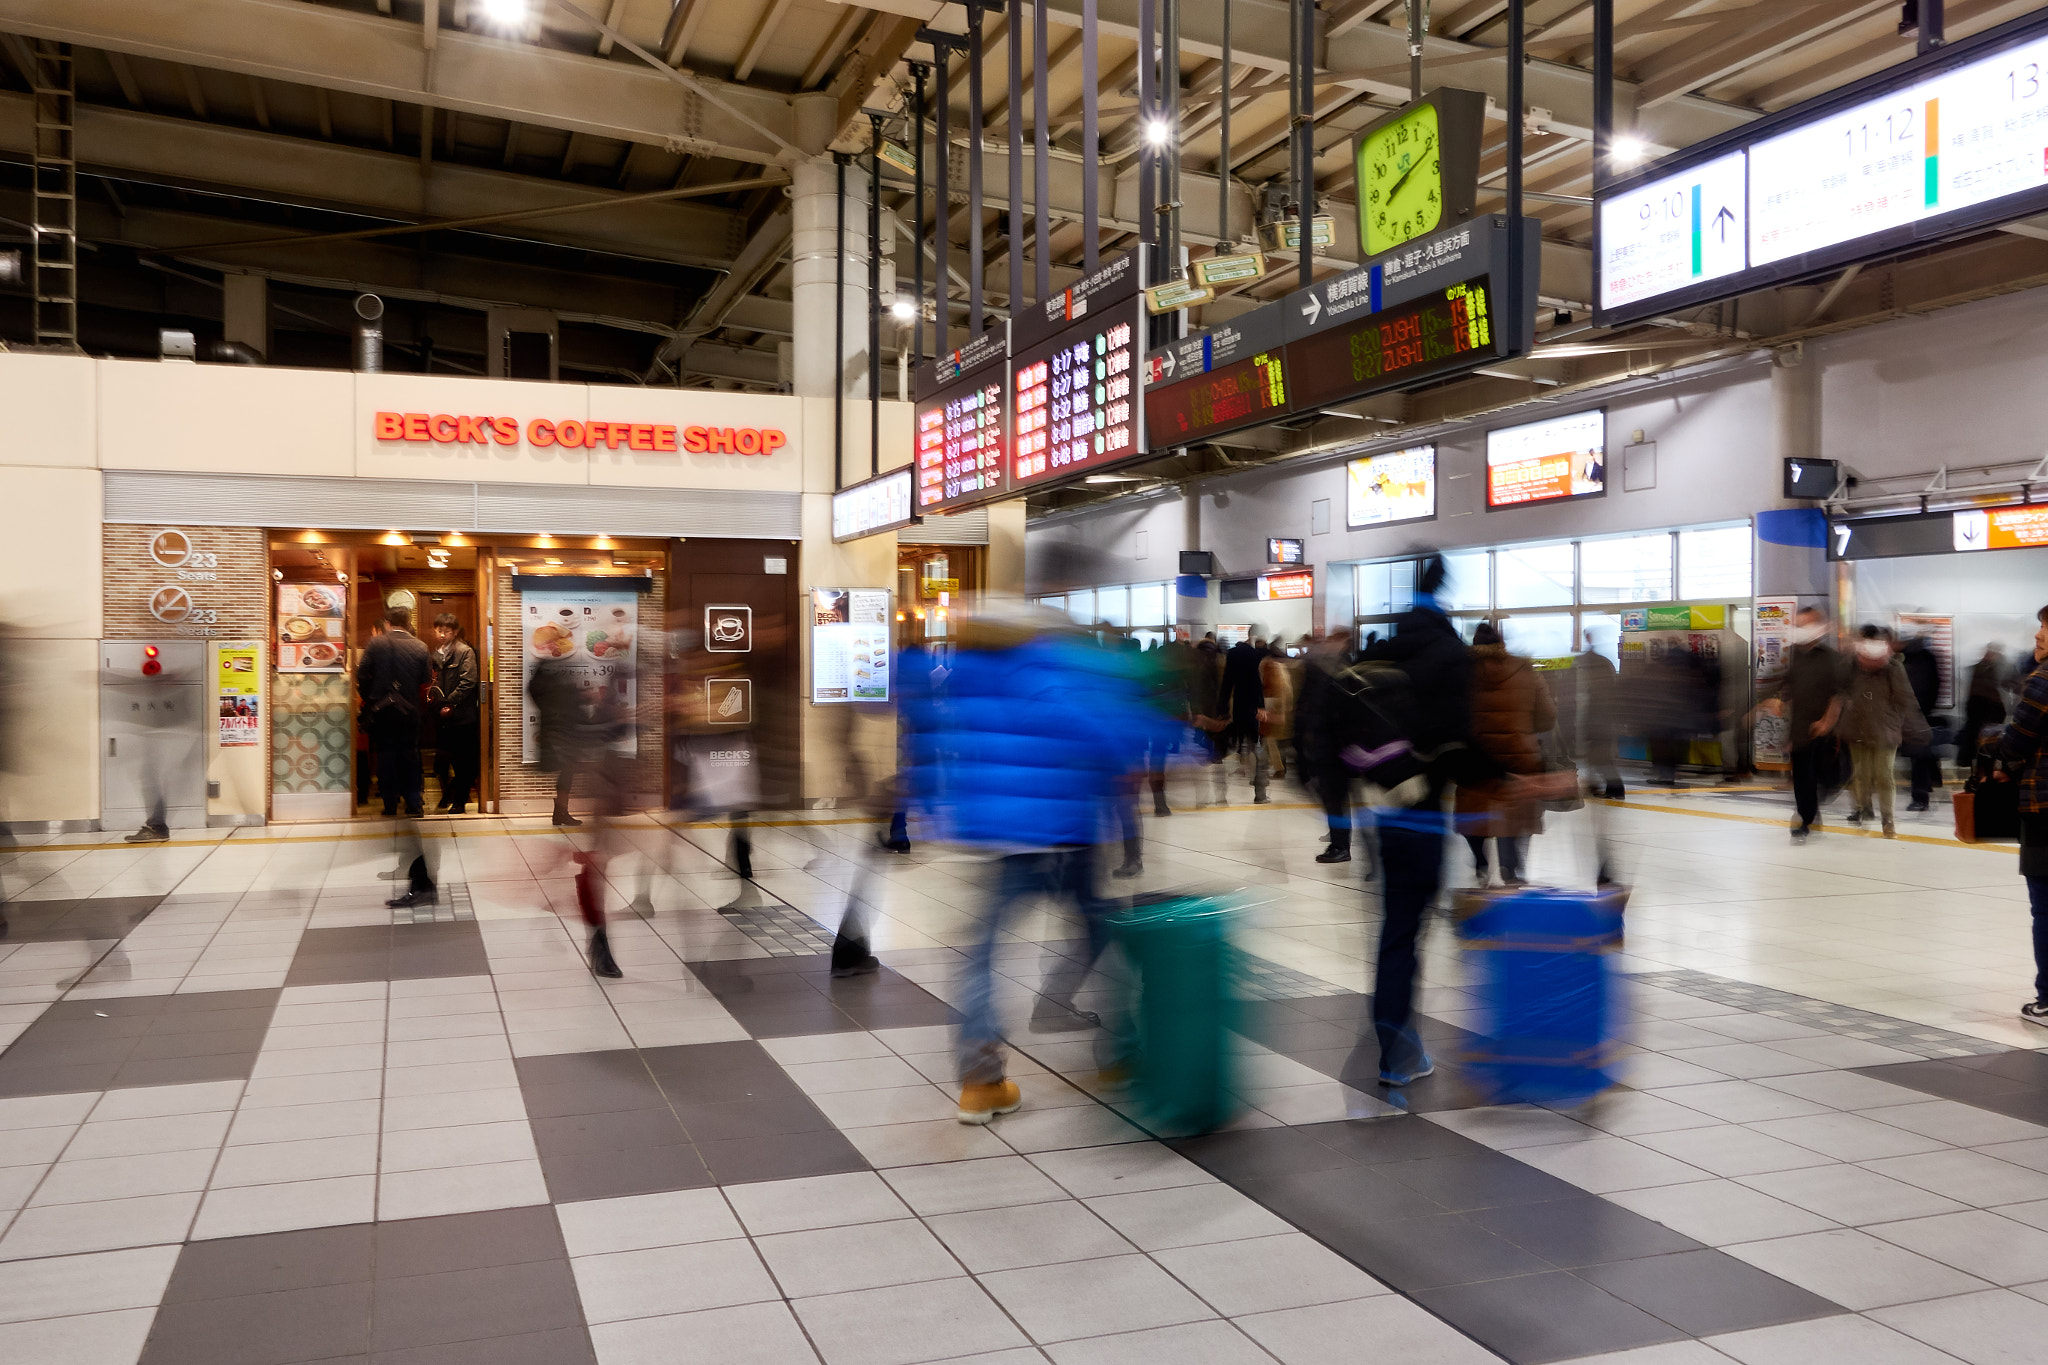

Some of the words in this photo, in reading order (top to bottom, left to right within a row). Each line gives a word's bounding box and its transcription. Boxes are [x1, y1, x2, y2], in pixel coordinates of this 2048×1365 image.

[1417, 264, 1432, 275] Zushi
[1327, 272, 1369, 303] 横須賀線
[1446, 283, 1467, 300] のりば
[1326, 298, 1355, 317] Yokosuka
[1355, 294, 1369, 307] Line
[1381, 313, 1421, 346] ZUSHI
[1052, 349, 1072, 375] 8:17
[1383, 341, 1424, 372] ZUSHI
[1052, 373, 1072, 398] 8:27
[1052, 398, 1071, 421] 8:32
[375, 411, 520, 446] BECK'S
[526, 418, 678, 453] COFFEE
[683, 425, 787, 456] SHOP
[1790, 463, 1802, 483] 7
[1834, 525, 1852, 556] 7
[177, 569, 217, 581] Seats
[1303, 575, 1312, 596] 6
[191, 609, 218, 624] 23
[220, 717, 258, 729] アルバイト募集
[710, 750, 750, 760] BECK'S
